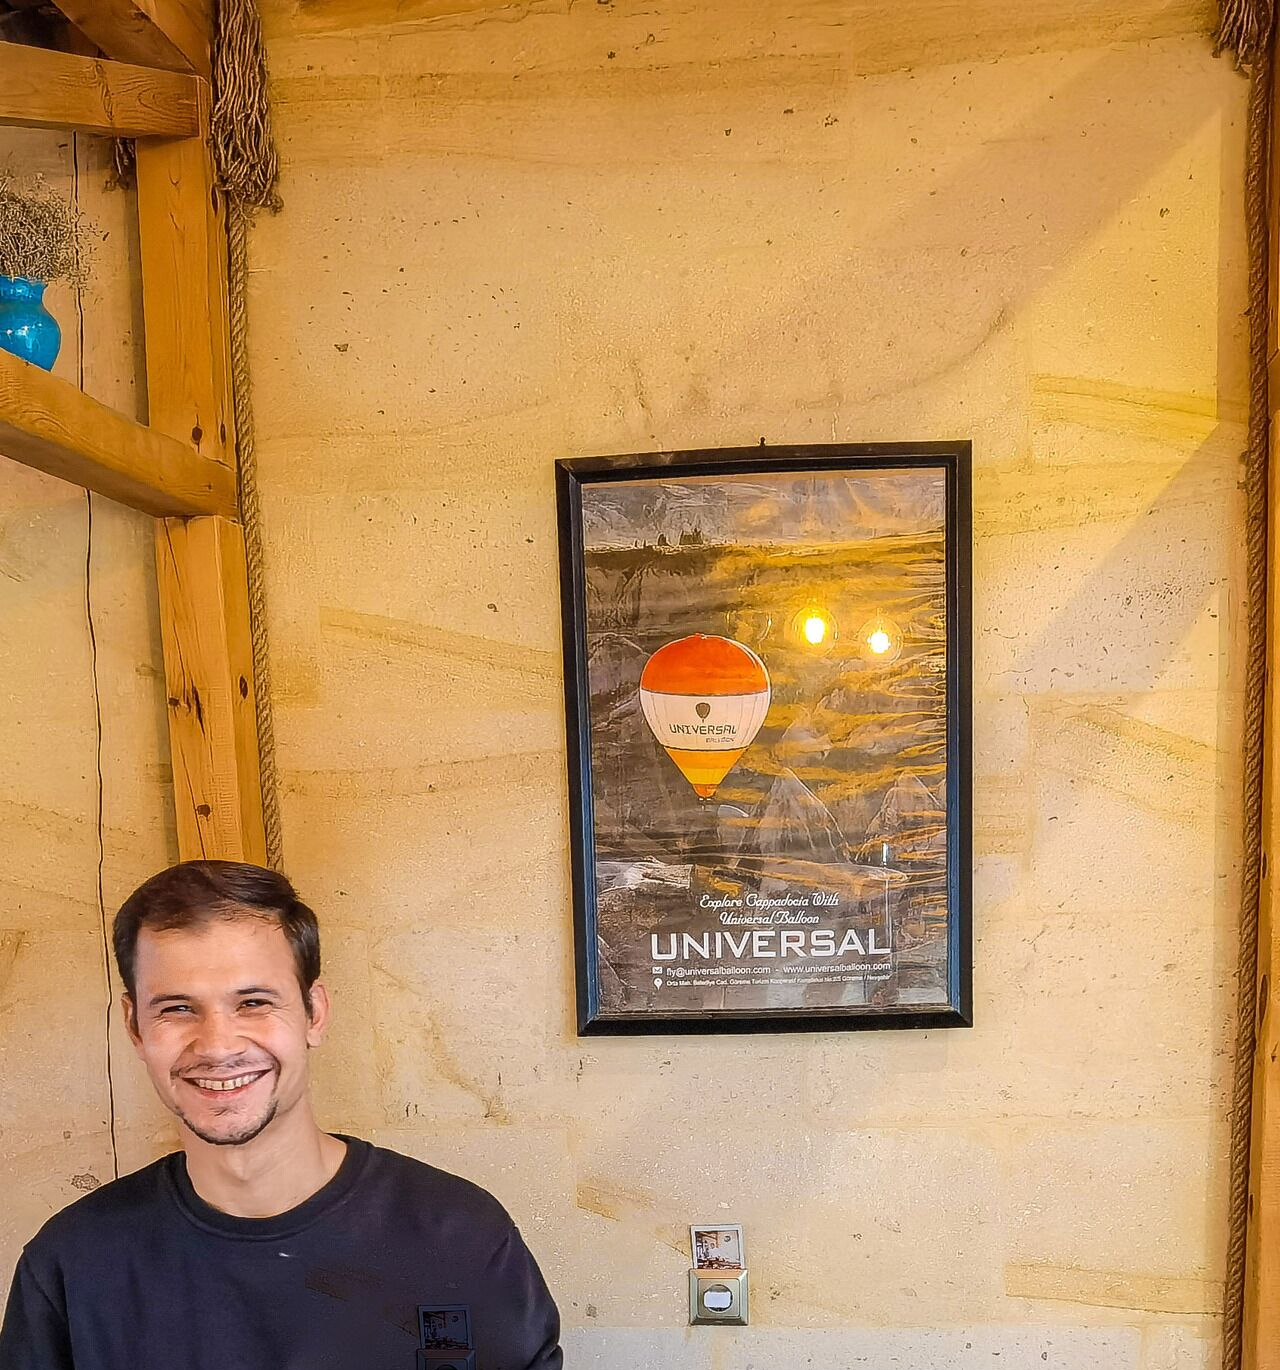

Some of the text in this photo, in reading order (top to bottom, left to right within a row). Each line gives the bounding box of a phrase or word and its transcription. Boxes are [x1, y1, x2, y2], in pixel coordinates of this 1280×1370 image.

[669, 724, 737, 735] UNIVERSAL
[699, 891, 839, 912] Explore Cappadocia With
[720, 911, 820, 925] Universal Balloon
[651, 929, 891, 960] UNIVERSAL
[666, 963, 891, 977] fly@universalballoon.com www.universalballoon.com
